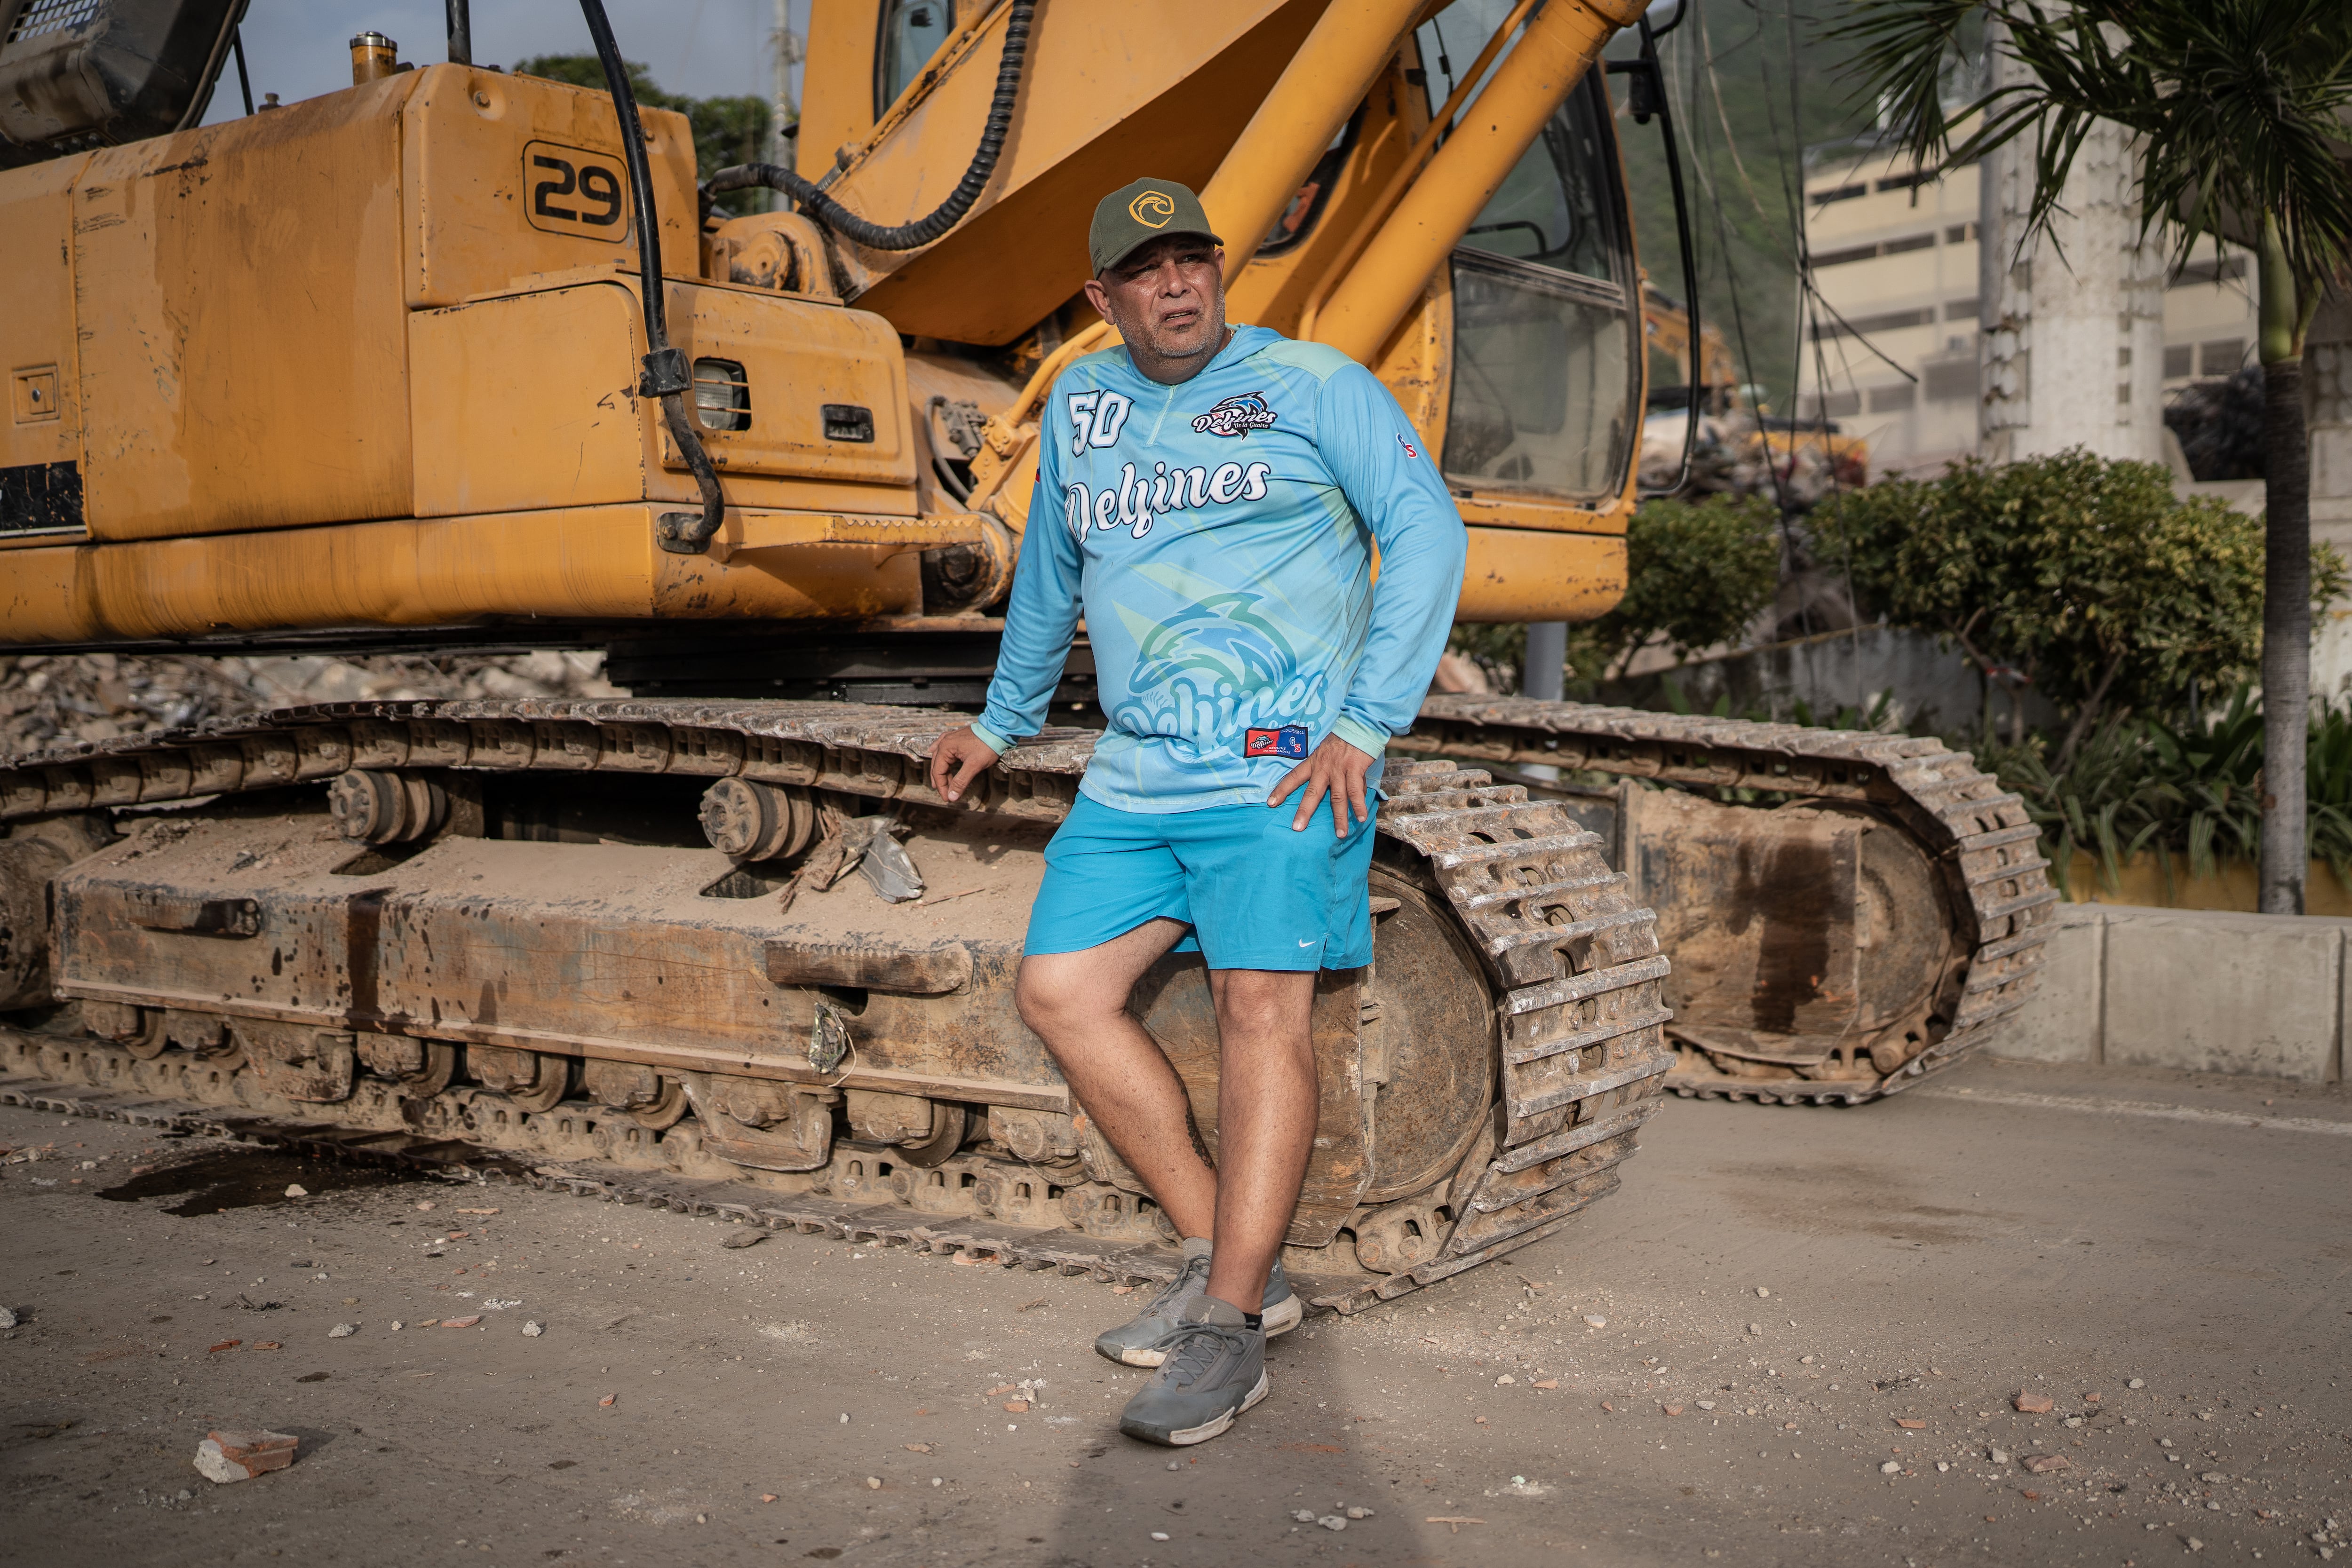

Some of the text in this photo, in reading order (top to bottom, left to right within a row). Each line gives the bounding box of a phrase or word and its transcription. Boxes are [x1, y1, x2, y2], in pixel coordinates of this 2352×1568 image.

[533, 155, 622, 226] 29
[1068, 389, 1136, 458] 50
[1191, 410, 1278, 433] Delfines
[1064, 461, 1271, 545] Delfines
[1116, 673, 1326, 754] Delfines
[1289, 736, 1301, 753] GS
